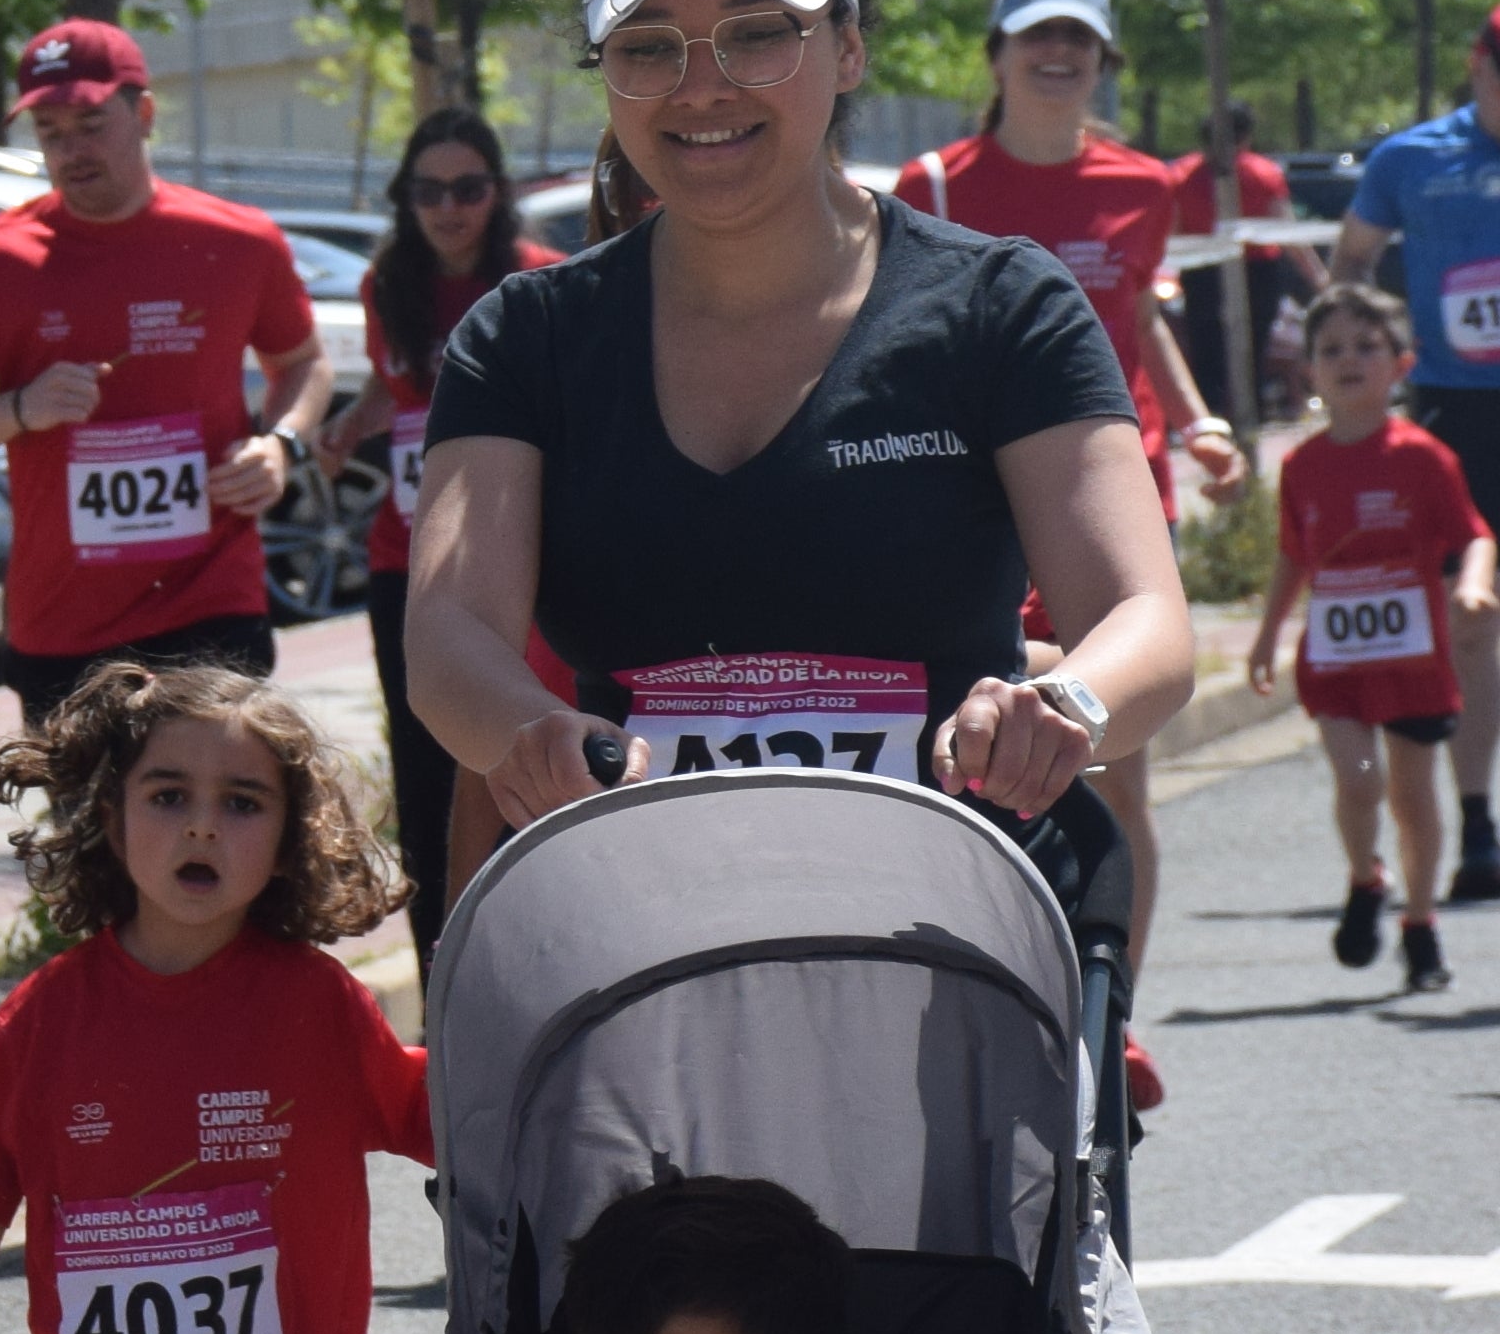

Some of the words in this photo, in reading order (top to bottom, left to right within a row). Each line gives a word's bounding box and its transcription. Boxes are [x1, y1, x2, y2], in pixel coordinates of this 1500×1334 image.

[78, 464, 200, 518] 4024
[1327, 600, 1407, 641] 000
[633, 660, 727, 682] CARRERA
[730, 657, 823, 667] CAMPUS
[779, 668, 808, 682] DE
[814, 668, 841, 680] LA
[846, 670, 908, 683] RIOJA
[645, 699, 710, 710] DOMINGO
[726, 701, 745, 712] DE
[749, 699, 792, 712] MAYO
[795, 696, 815, 707] DE
[819, 697, 856, 707] 2022
[198, 1090, 271, 1108] CARRERA
[199, 1109, 264, 1126] CAMPUS
[200, 1123, 292, 1144] UNIVERSIDAD
[200, 1147, 221, 1162] DE
[224, 1146, 242, 1160] LA
[65, 1211, 133, 1227] CARRERA
[136, 1203, 207, 1222] CAMPUS
[65, 1224, 171, 1244] UNIVERSIDAD
[175, 1222, 198, 1235] DE
[201, 1220, 221, 1232] LA
[223, 1210, 260, 1229] RIOJA
[66, 1255, 119, 1267] DOMINGO
[121, 1254, 131, 1263] 15
[133, 1253, 149, 1262] DE
[152, 1248, 187, 1262] MAYO
[190, 1248, 205, 1257] DE
[208, 1242, 235, 1256] 2022
